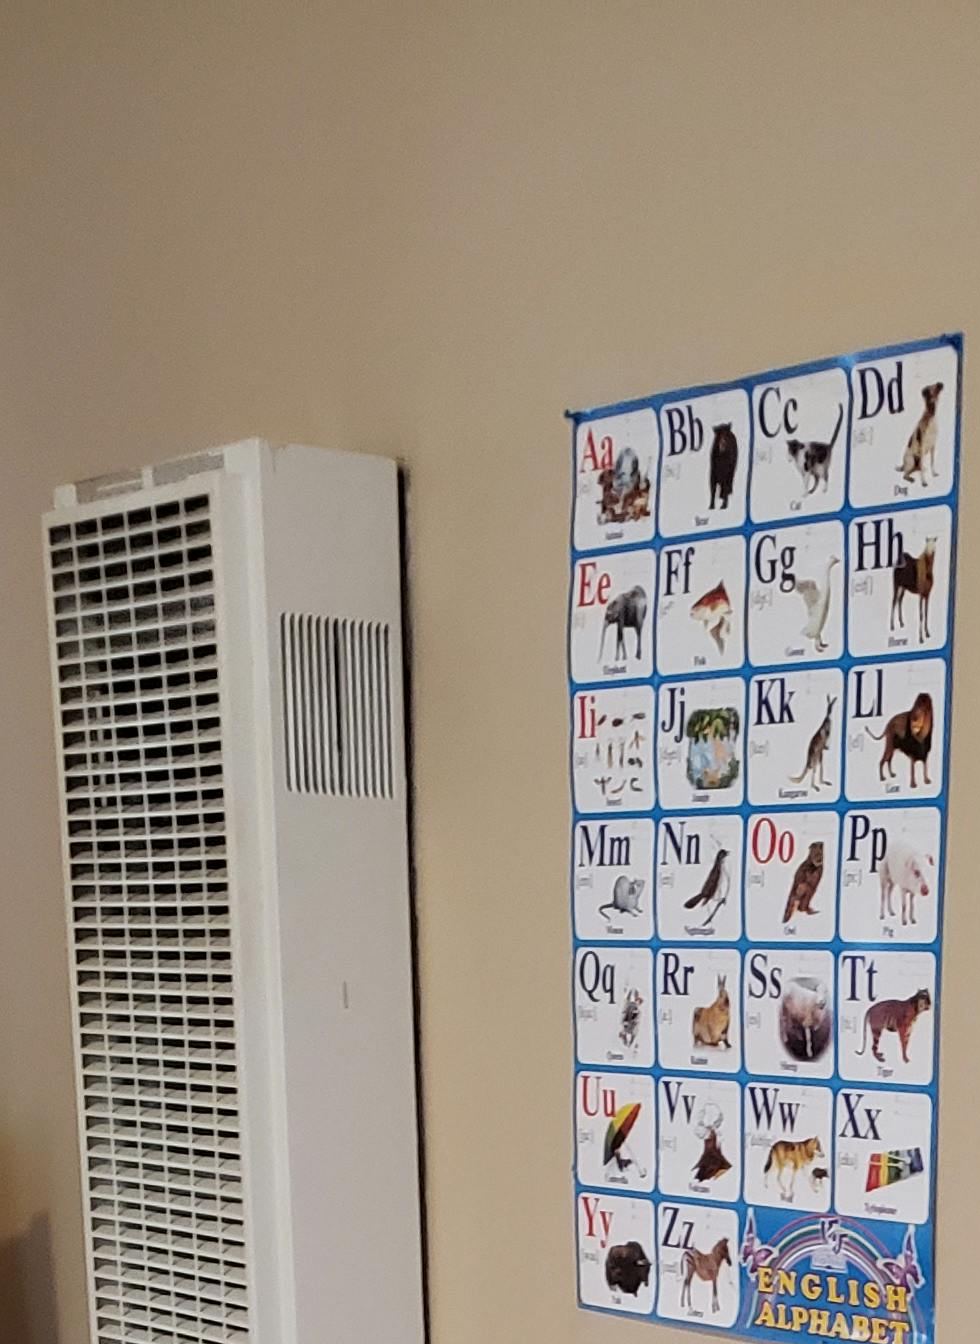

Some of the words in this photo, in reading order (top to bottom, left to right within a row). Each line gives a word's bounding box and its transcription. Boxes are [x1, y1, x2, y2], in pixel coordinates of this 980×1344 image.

[759, 387, 798, 438] Cc
[857, 361, 904, 420] Dd
[580, 427, 614, 473] Aa
[665, 405, 703, 456] Bb
[755, 534, 797, 593] Gg
[854, 518, 905, 572] Hh
[577, 562, 611, 607] Ee
[664, 547, 695, 596] Ff
[577, 695, 597, 739] Ii
[661, 687, 686, 743] Jj
[753, 677, 796, 726] Kk
[852, 669, 883, 719] Ll
[578, 824, 631, 867] Mm
[660, 821, 701, 866] Nn
[752, 817, 795, 864] Oo
[846, 814, 887, 873] Pp
[579, 950, 616, 1004] Qq
[660, 952, 695, 996] Rr
[749, 953, 782, 999] Ss
[841, 955, 878, 1002] Tt
[581, 1075, 617, 1118] Uu
[662, 1081, 696, 1124] Vv
[748, 1086, 801, 1134] Ww
[838, 1093, 882, 1141] Xx
[581, 1196, 614, 1249] Yy
[662, 1206, 696, 1250] Zz
[757, 1266, 908, 1313] ENGLISH
